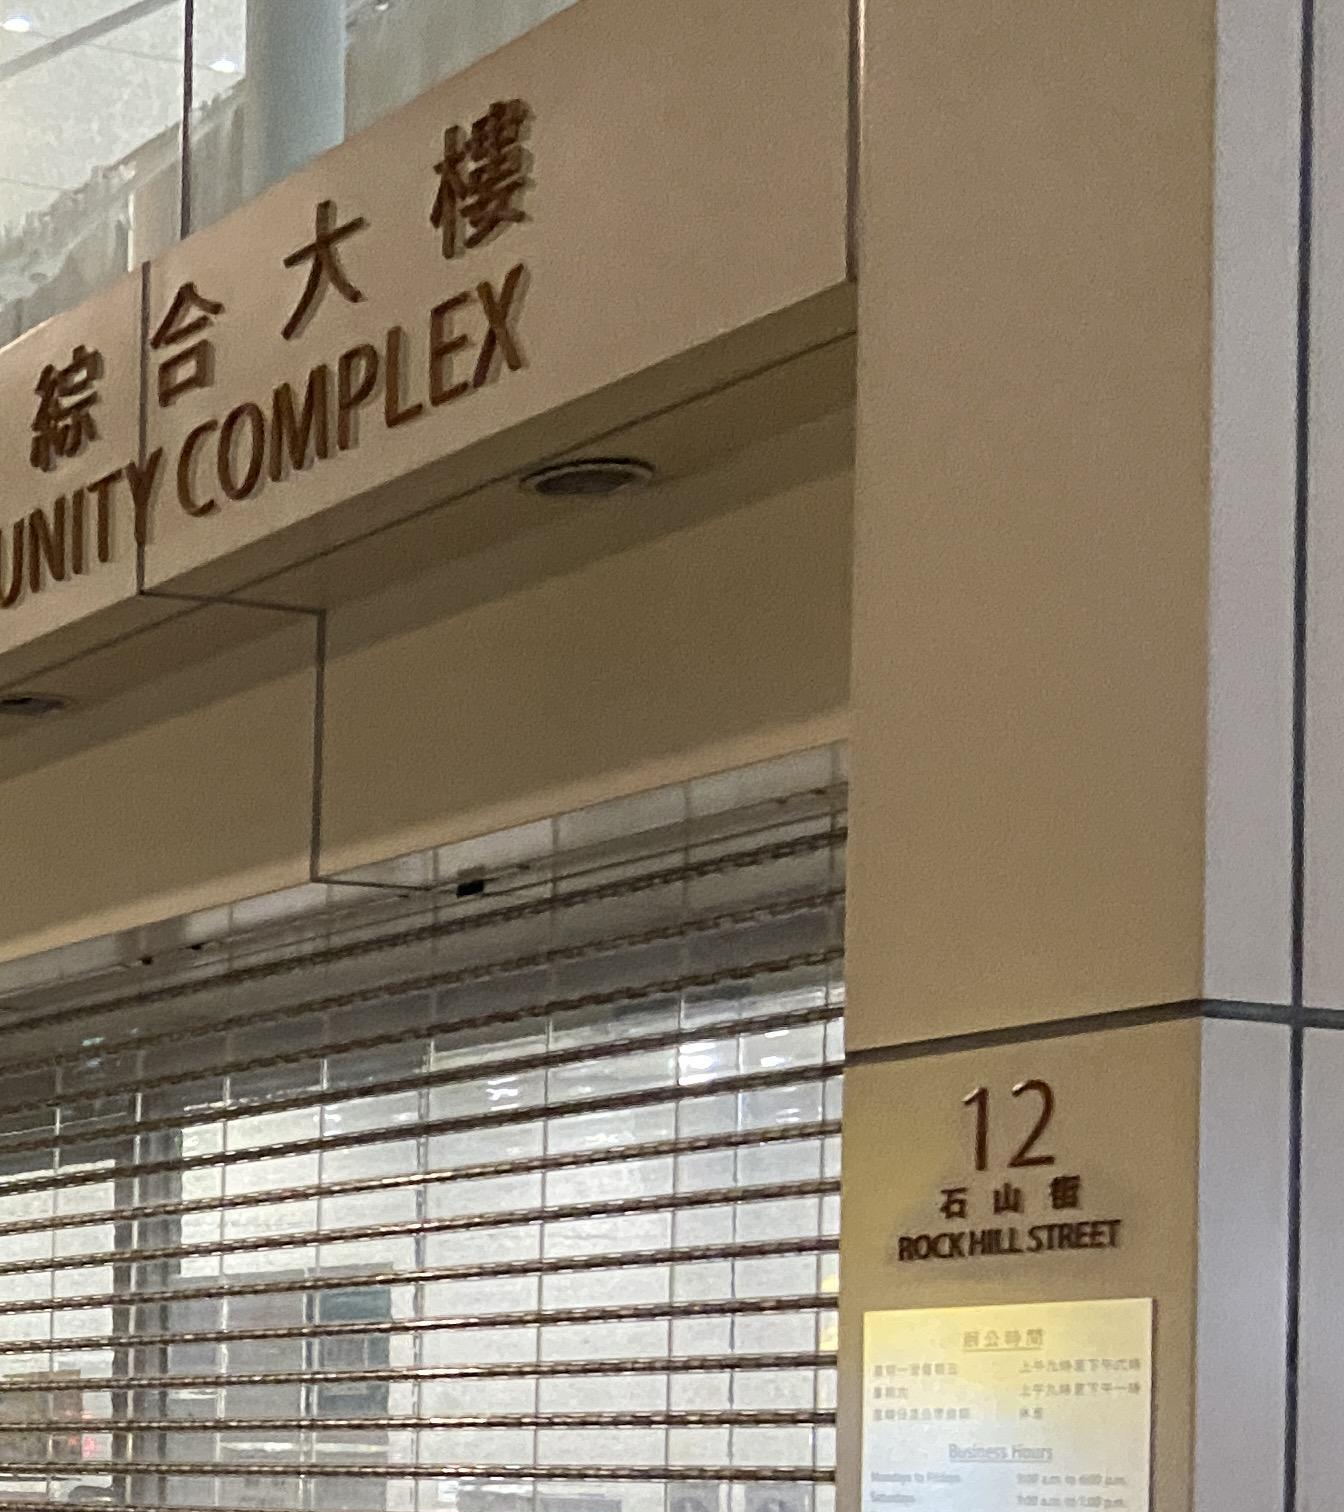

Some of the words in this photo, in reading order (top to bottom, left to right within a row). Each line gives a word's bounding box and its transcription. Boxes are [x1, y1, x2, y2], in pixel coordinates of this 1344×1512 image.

[176, 263, 527, 517] COMPLEX
[962, 1078, 1056, 1171] 12
[897, 1231, 965, 1261] ROCK
[967, 1227, 1023, 1256] HILL
[1027, 1219, 1122, 1252] STREET
[948, 1444, 1008, 1460] Business
[1011, 1444, 1054, 1461] Hours
